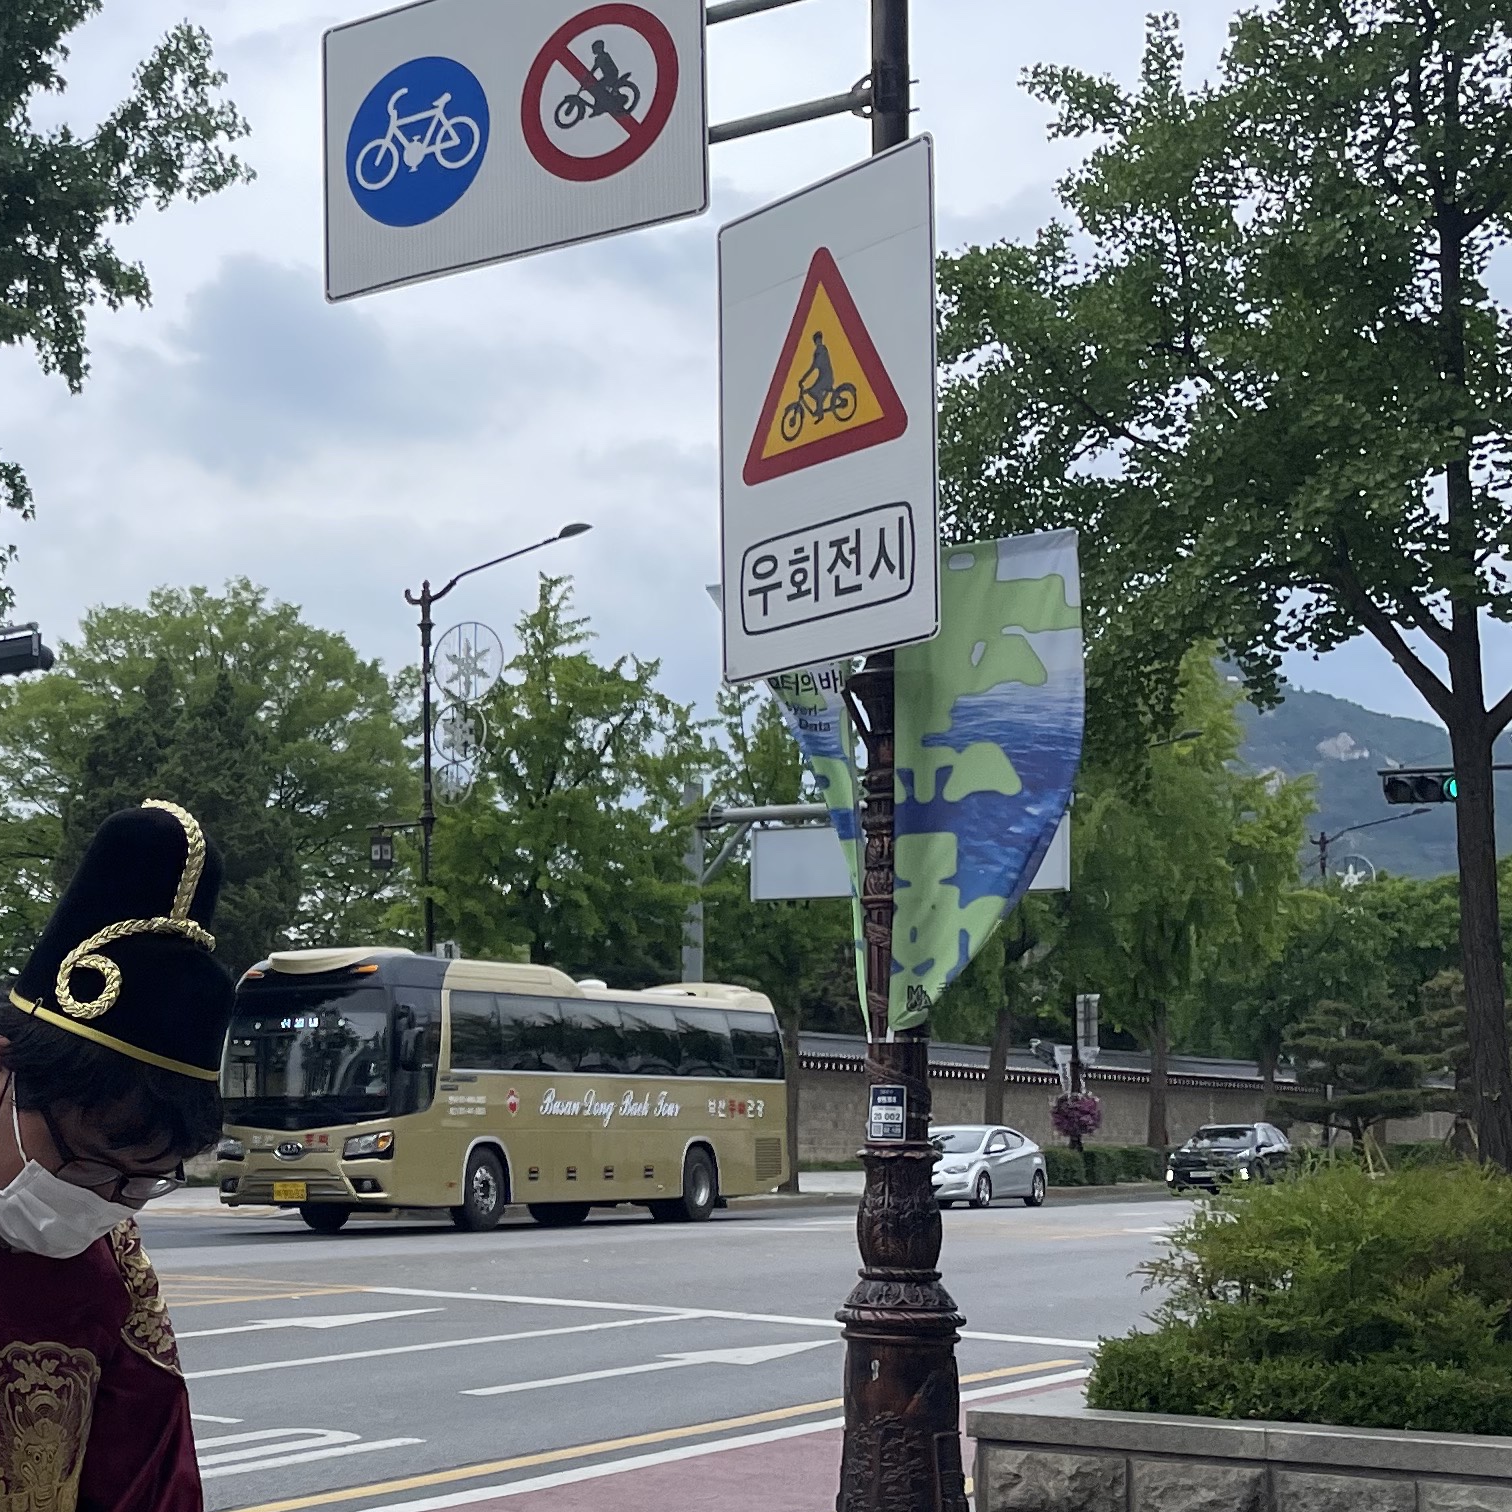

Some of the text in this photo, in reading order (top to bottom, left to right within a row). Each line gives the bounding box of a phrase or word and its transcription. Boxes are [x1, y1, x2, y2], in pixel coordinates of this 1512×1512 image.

[746, 515, 906, 616] 우회전시
[799, 718, 830, 733] Data
[539, 1087, 582, 1115] Busan
